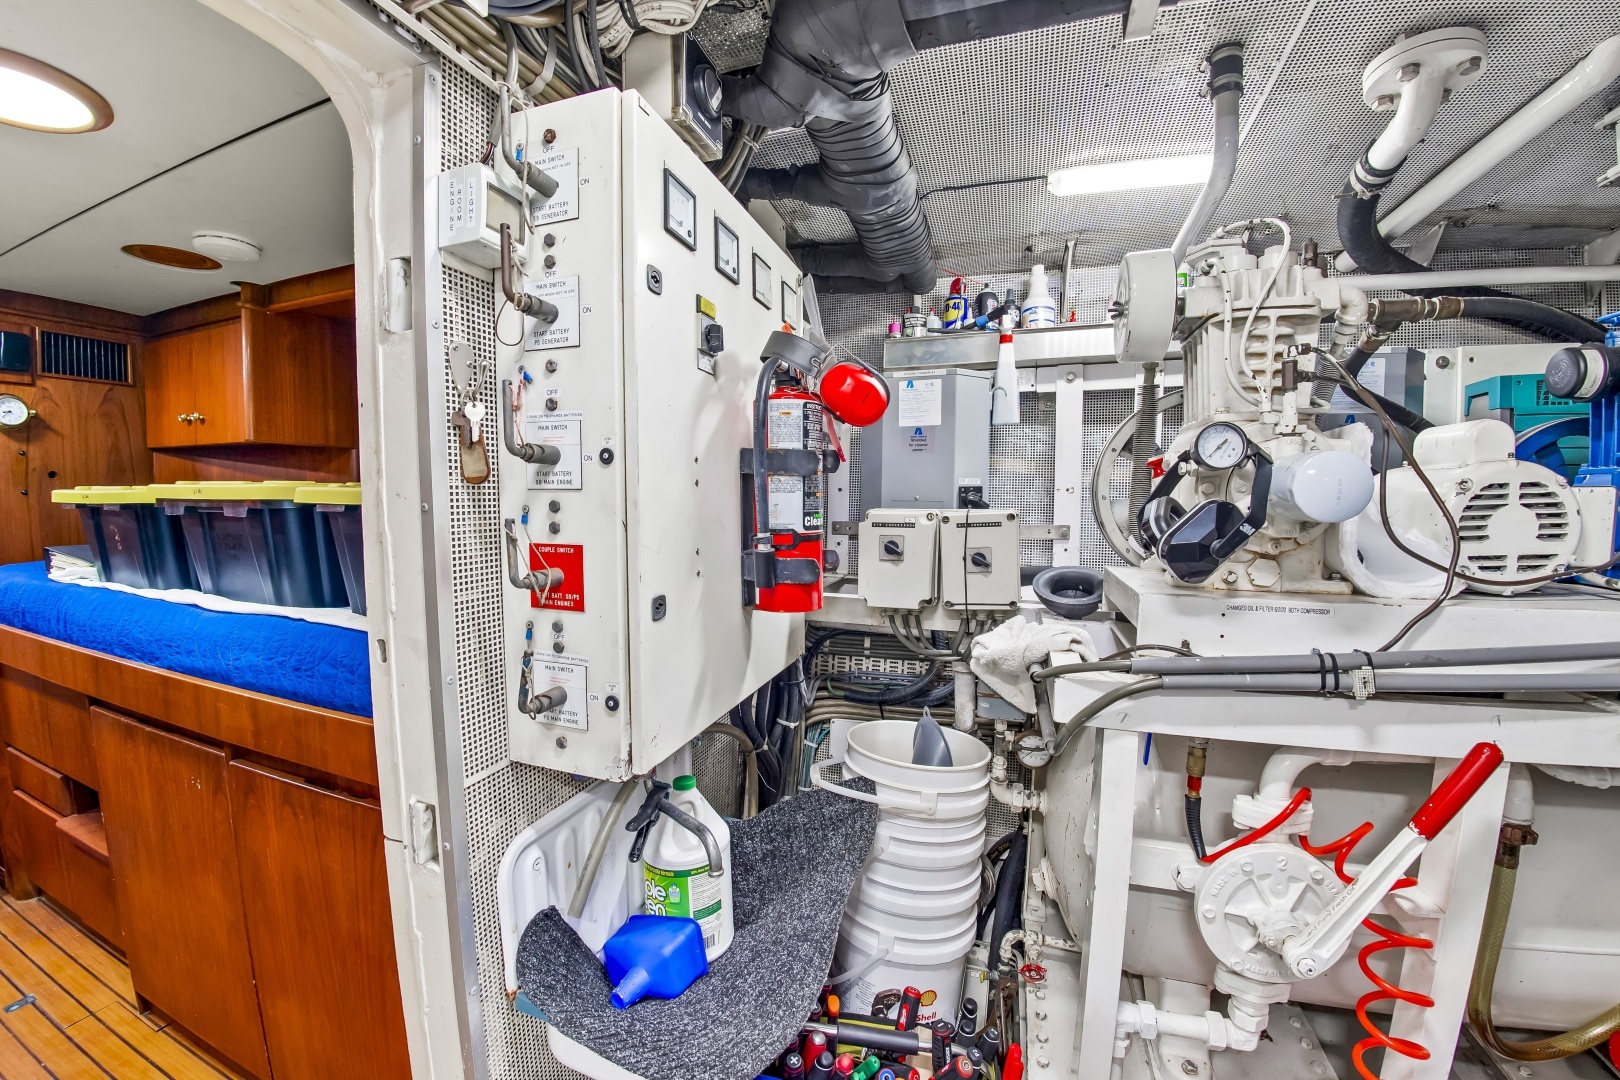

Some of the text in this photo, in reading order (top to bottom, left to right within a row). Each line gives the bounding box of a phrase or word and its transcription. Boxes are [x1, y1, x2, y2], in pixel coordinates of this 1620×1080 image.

[542, 145, 554, 154] OFF
[548, 154, 565, 164] SWITCH
[580, 178, 590, 186] ON
[532, 201, 569, 214] START BATTERY
[541, 210, 568, 220] GENERATOR
[549, 281, 566, 289] SWITCH
[944, 301, 962, 313] D-40
[542, 336, 569, 345] GENERATOR
[1278, 856, 1288, 872] 2
[1210, 876, 1229, 898] MADE
[916, 1012, 936, 1022] Shell
